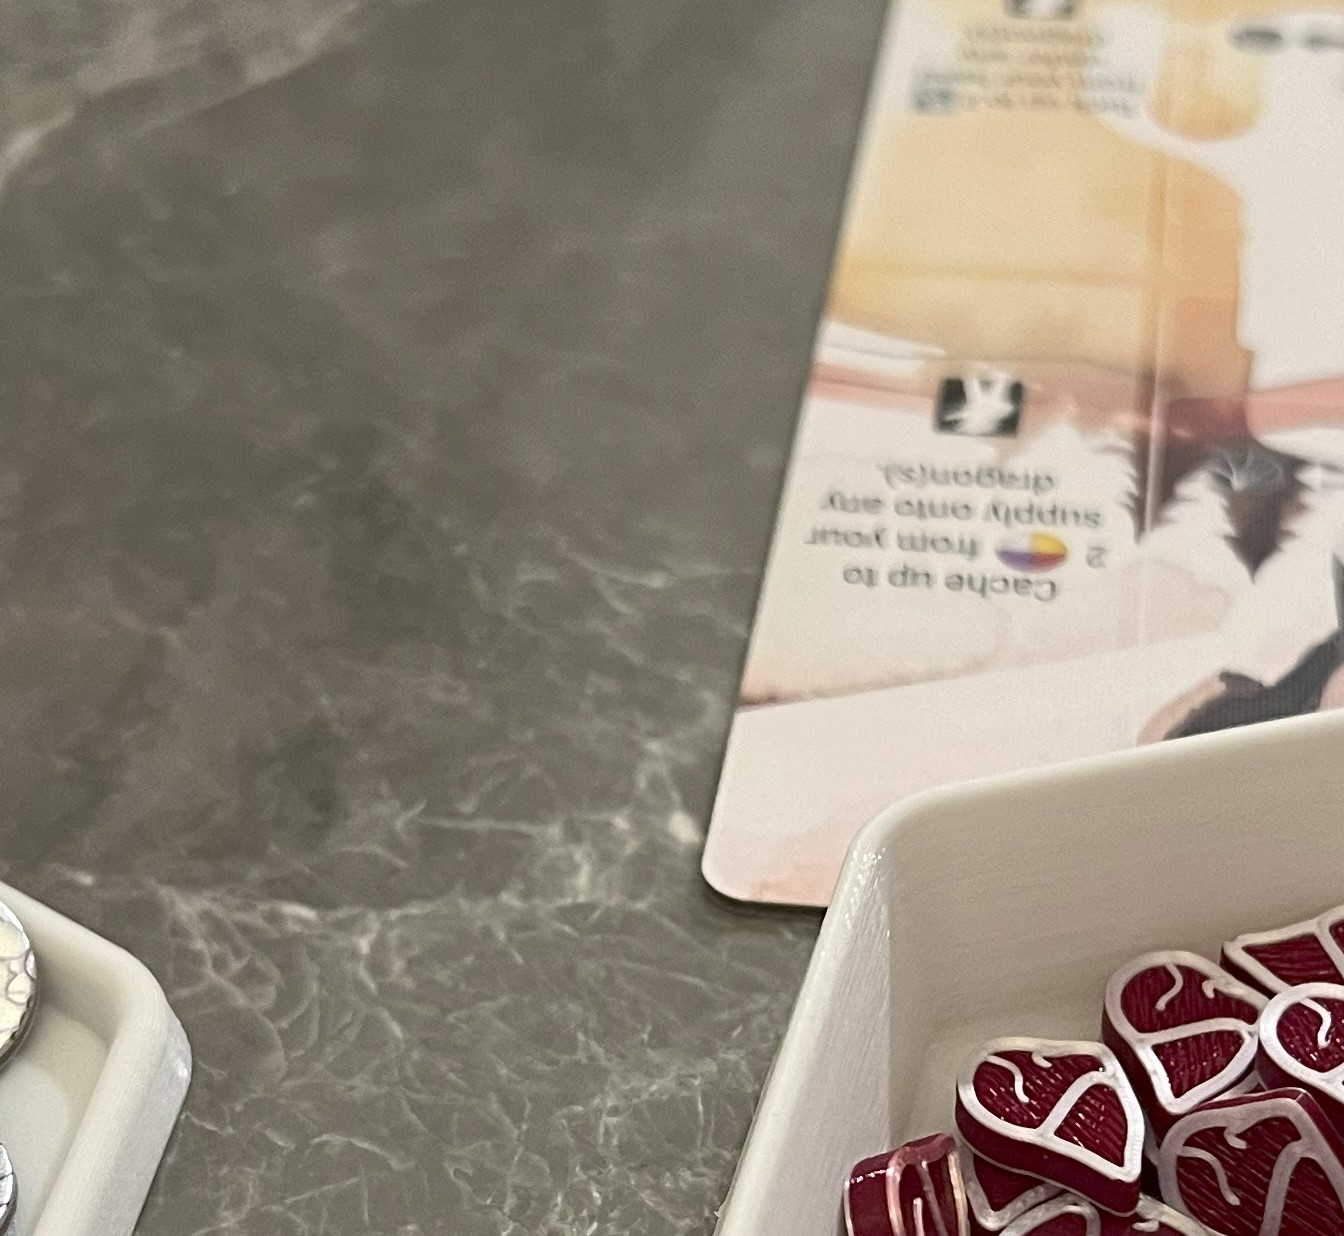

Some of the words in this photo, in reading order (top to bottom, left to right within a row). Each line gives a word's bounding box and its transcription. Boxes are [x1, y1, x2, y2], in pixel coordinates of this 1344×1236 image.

[822, 491, 882, 514] any
[894, 499, 976, 520] onto
[984, 502, 1101, 529] supply
[804, 527, 887, 549] your
[897, 532, 979, 560] from
[1086, 545, 1106, 568] 2
[843, 566, 878, 587] to
[888, 565, 934, 588] up
[944, 573, 1057, 602] Cache
